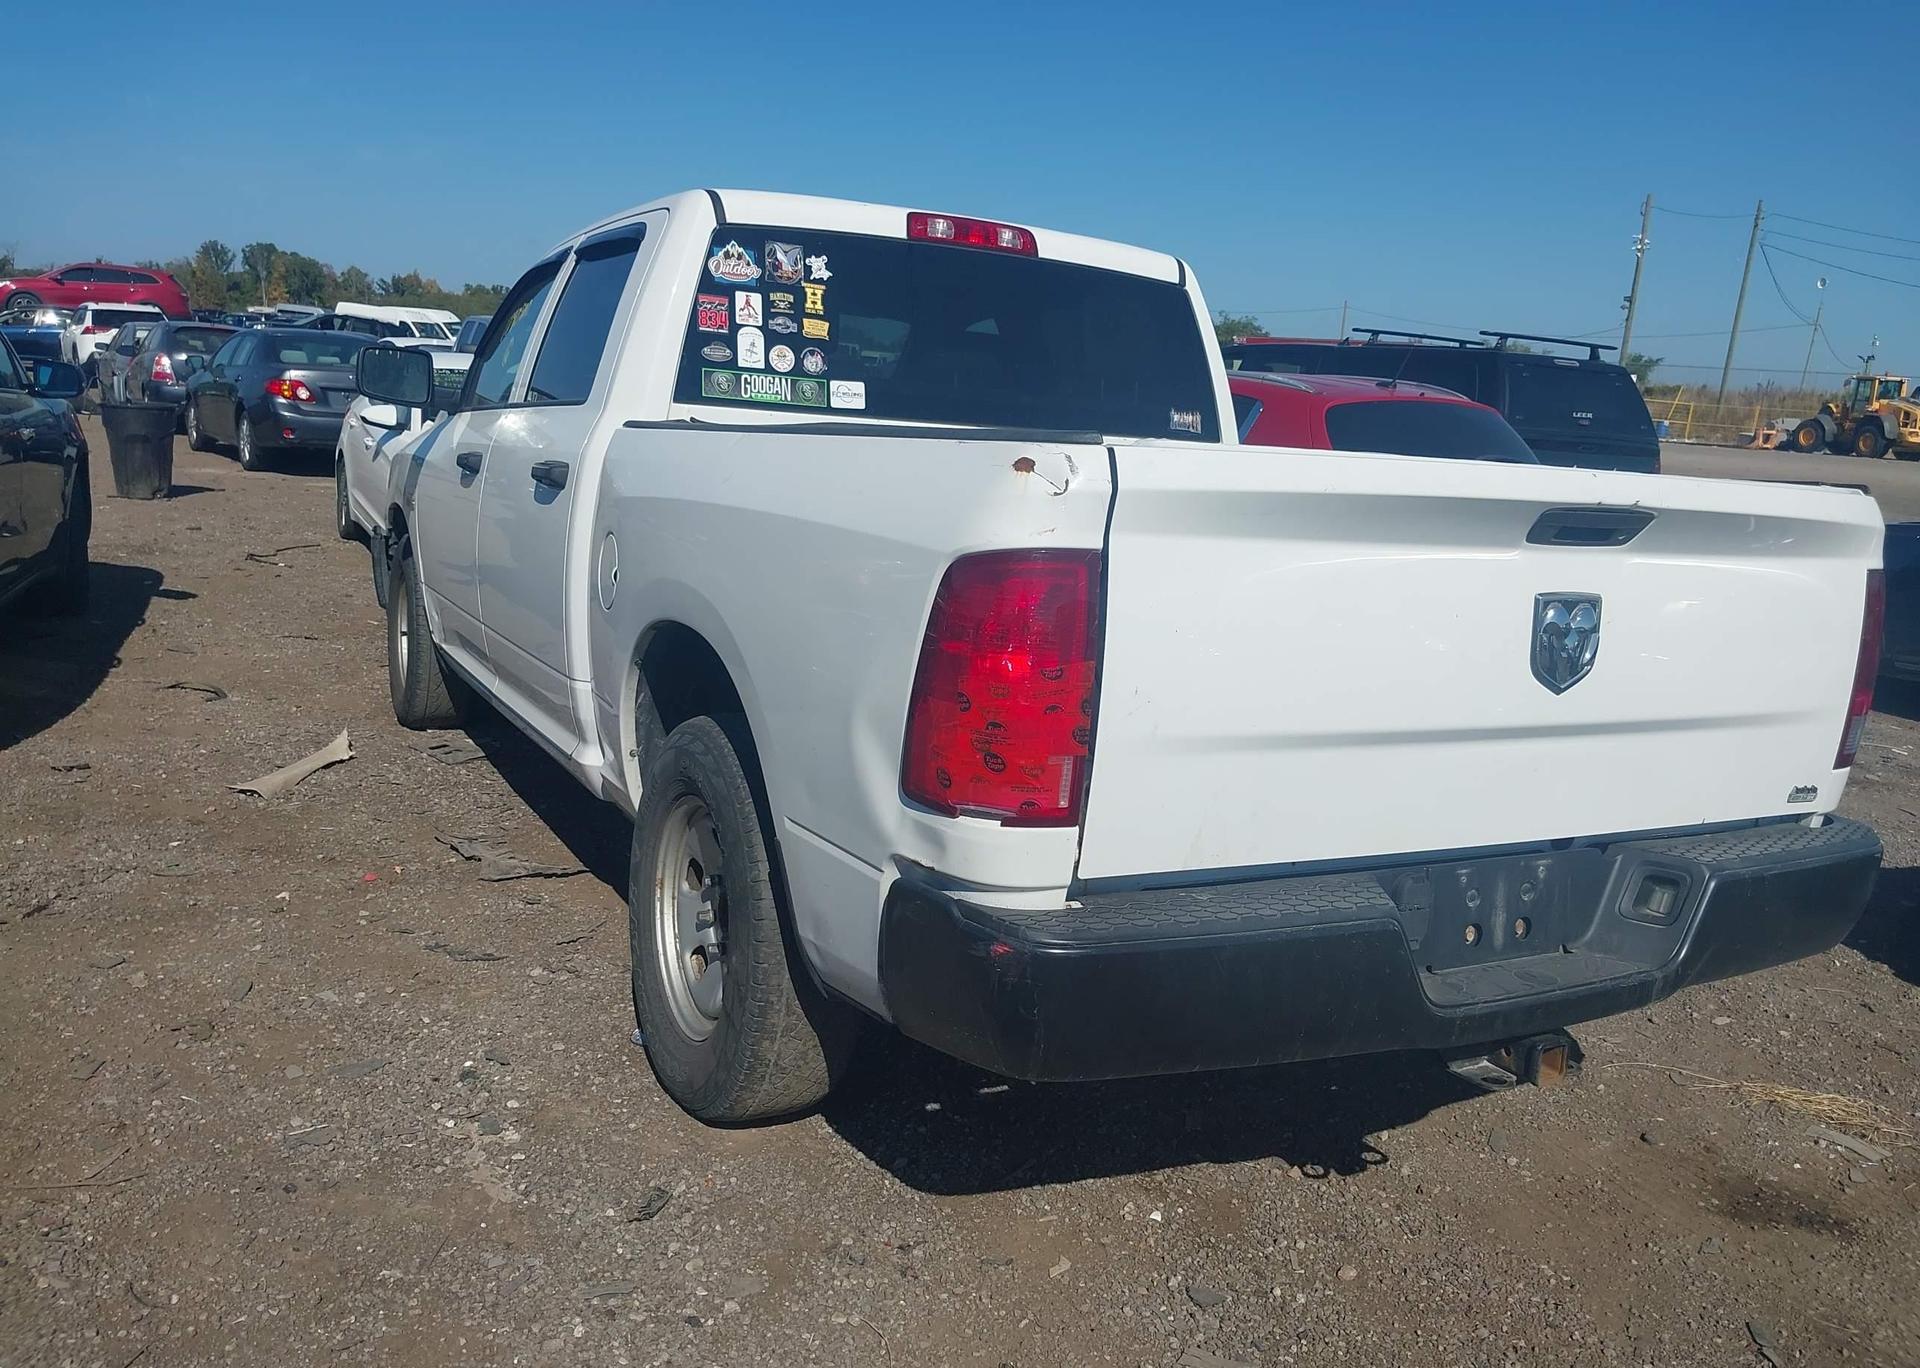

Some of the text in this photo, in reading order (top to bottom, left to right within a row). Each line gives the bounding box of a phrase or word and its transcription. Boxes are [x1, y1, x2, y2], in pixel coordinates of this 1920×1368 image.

[712, 258, 762, 276] Outdoor
[699, 309, 729, 329] 834
[741, 374, 791, 402] GOOGAN
[1572, 411, 1593, 419] LEER
